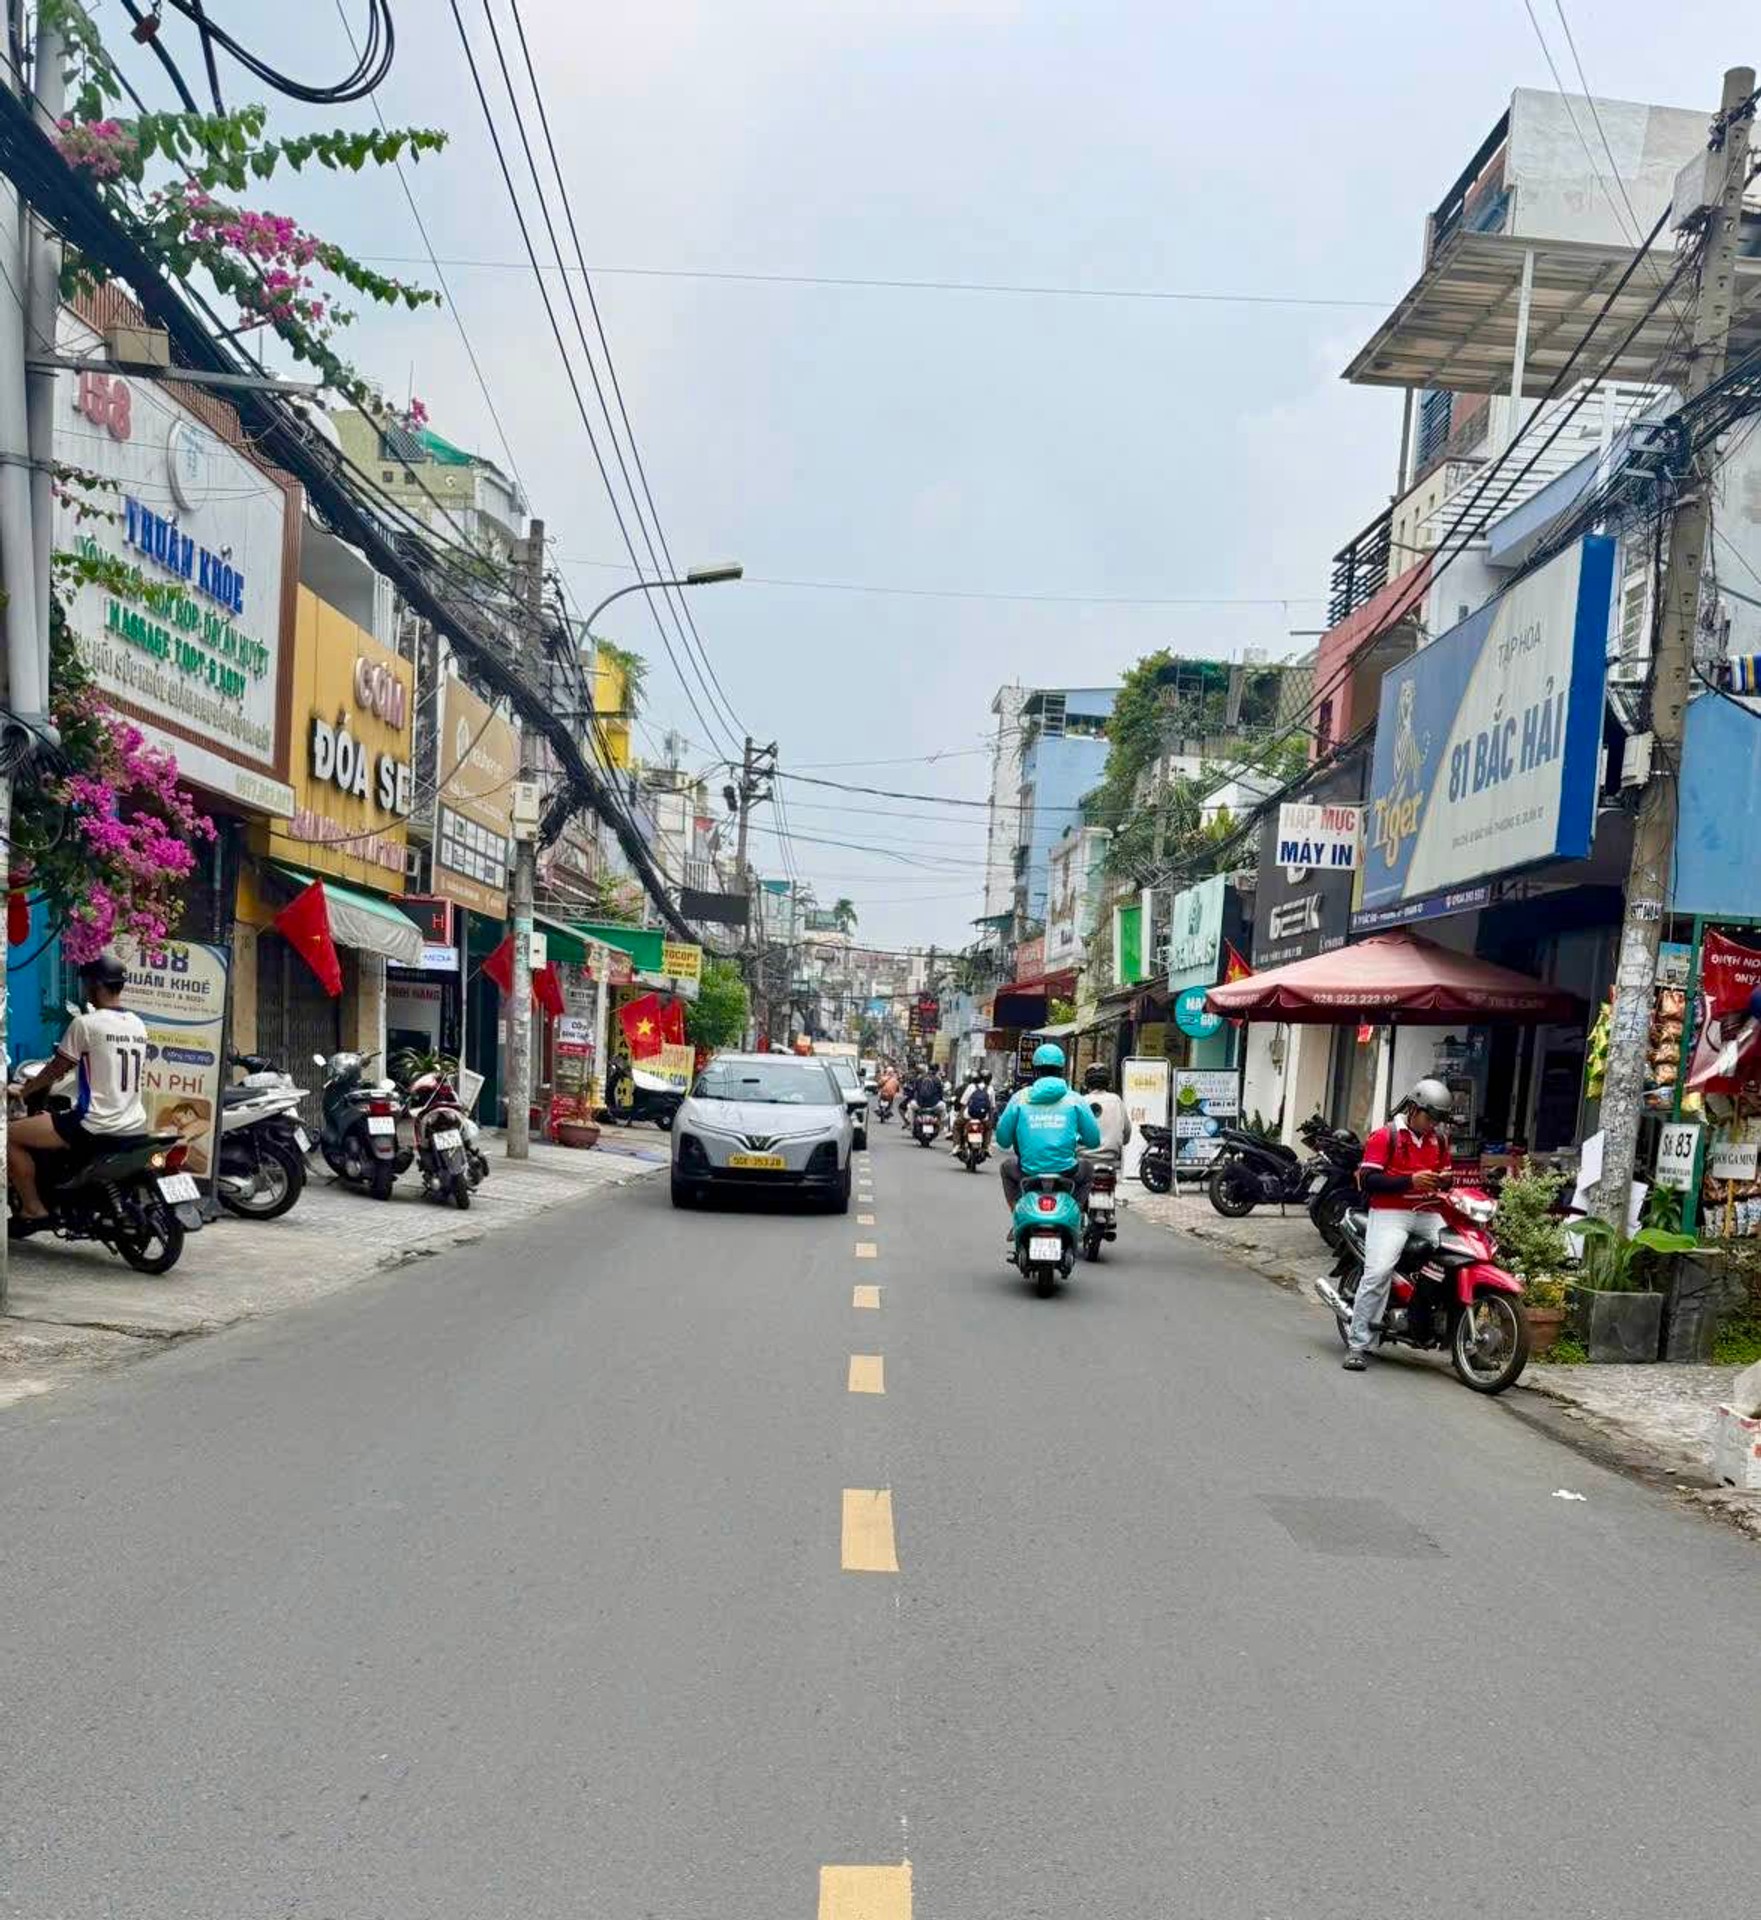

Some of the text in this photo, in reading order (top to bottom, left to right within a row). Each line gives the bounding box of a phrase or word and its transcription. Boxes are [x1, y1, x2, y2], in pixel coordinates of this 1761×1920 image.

[104, 598, 171, 662] MASSAGE
[1449, 675, 1565, 803] 81 BẮC HẢI
[1320, 807, 1356, 836] MỰC
[1372, 790, 1424, 869] Tiger
[1281, 838, 1353, 866] MÁY IN
[117, 1047, 141, 1093] 11
[169, 1073, 205, 1093] PHÍ
[1675, 1132, 1693, 1158] 83
